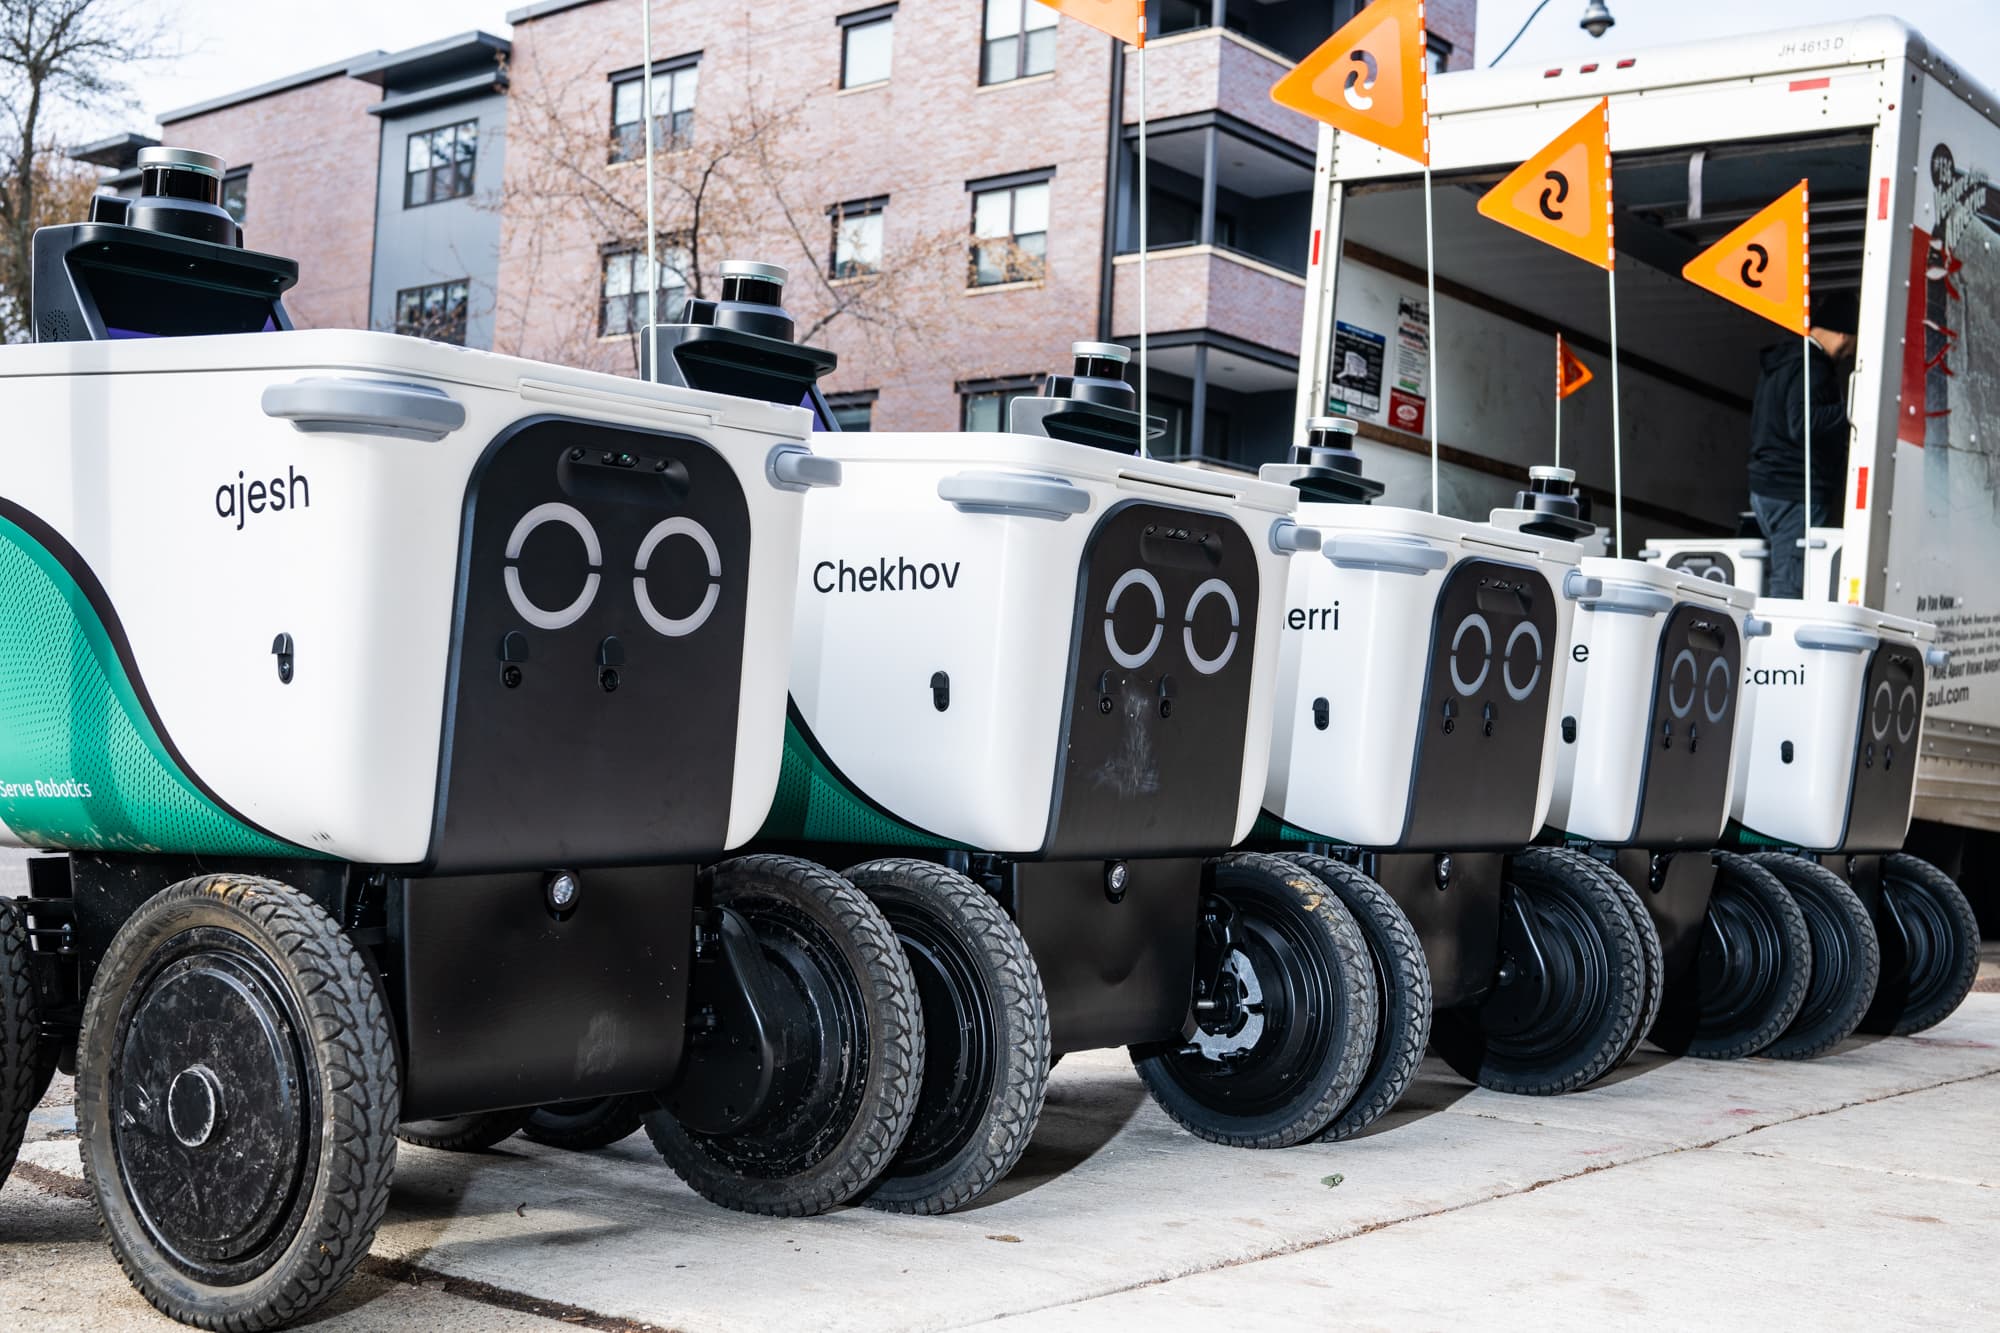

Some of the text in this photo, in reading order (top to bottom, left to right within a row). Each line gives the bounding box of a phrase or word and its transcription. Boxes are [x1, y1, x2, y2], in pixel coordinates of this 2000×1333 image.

[1778, 36, 1844, 57] JH 4613 D
[215, 465, 310, 531] ajesh
[813, 556, 961, 593] Chekhov
[1282, 600, 1340, 631] erri
[0, 777, 92, 798] Serve Robotics
